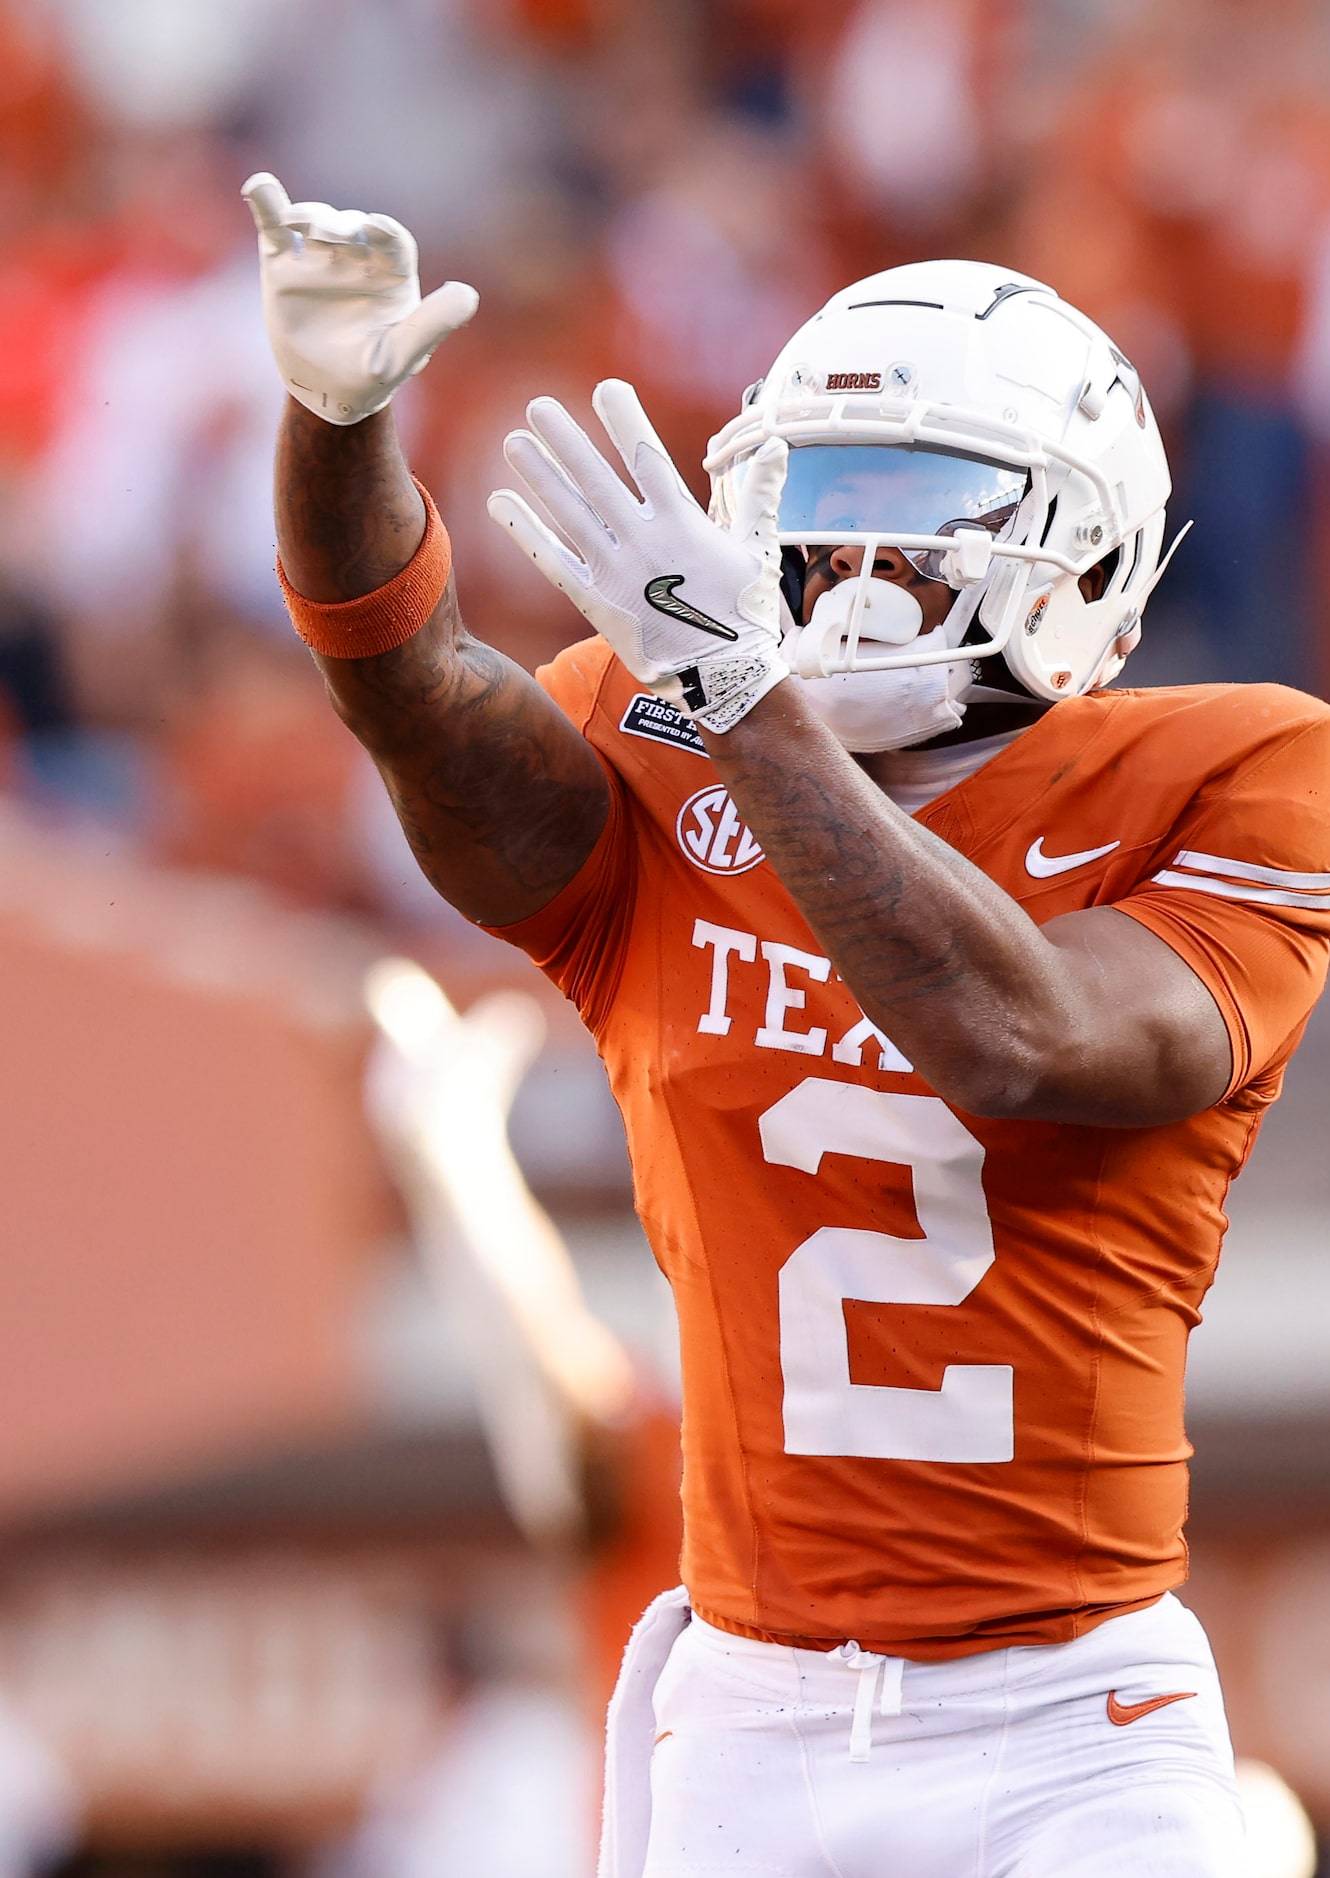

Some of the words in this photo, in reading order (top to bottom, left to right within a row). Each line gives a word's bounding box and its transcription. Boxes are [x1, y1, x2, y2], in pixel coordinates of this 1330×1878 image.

[826, 373, 881, 390] HORNS
[634, 700, 684, 725] FIRST
[638, 718, 681, 737] PRESENTED
[680, 731, 692, 741] BY
[758, 1077, 1014, 1463] 2
